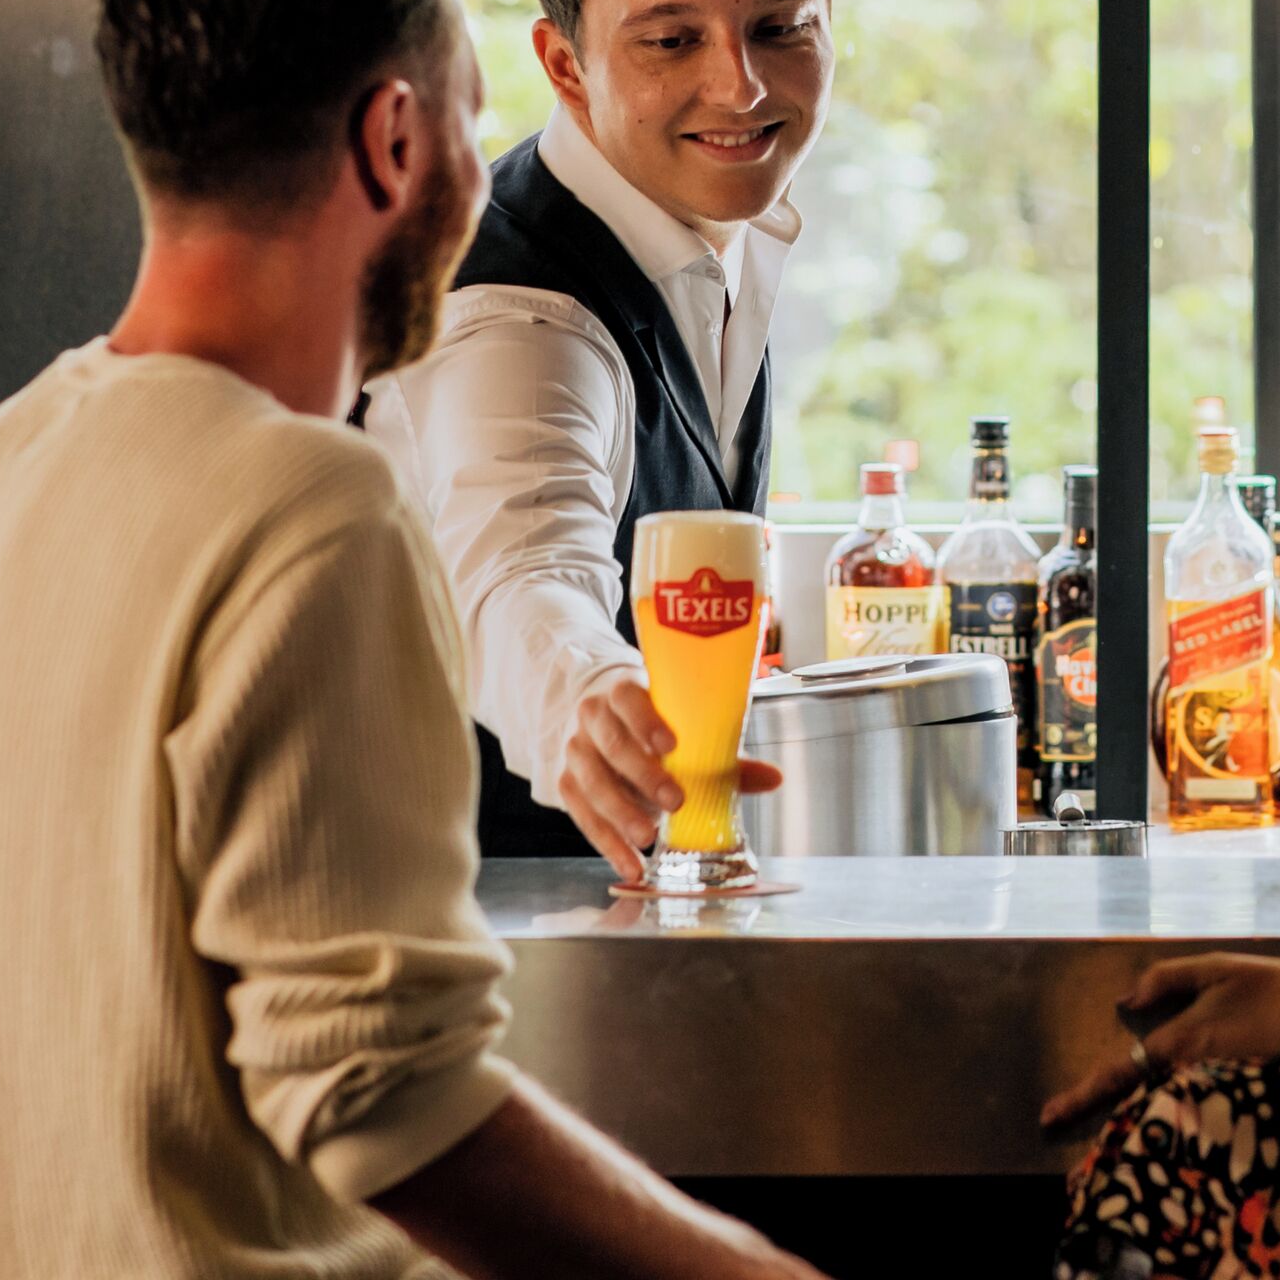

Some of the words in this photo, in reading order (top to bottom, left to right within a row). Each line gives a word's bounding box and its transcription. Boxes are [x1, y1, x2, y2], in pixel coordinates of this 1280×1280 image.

[659, 588, 749, 623] TEXELS
[1174, 632, 1208, 655] RED
[1211, 612, 1265, 641] LABEL
